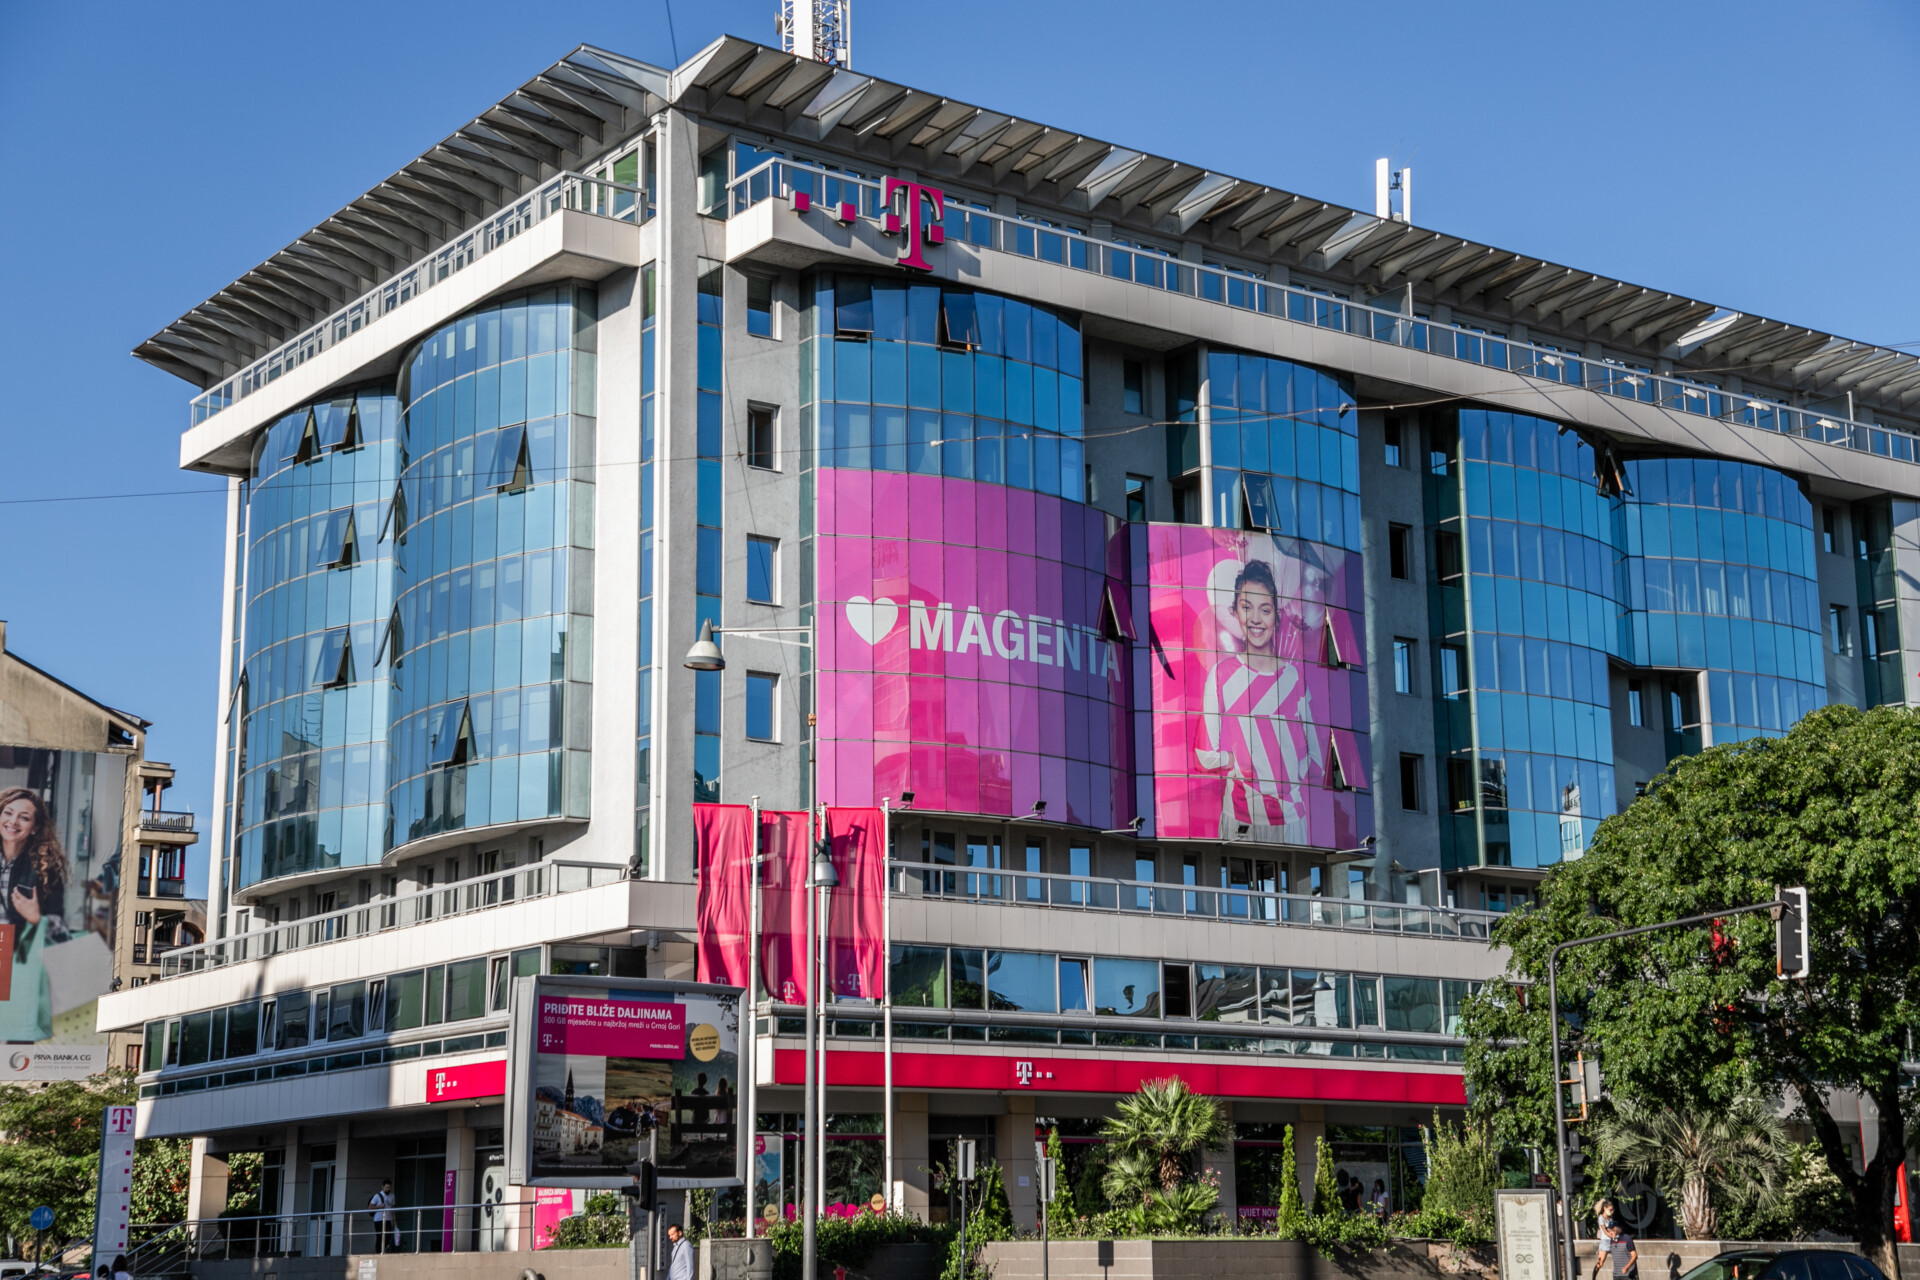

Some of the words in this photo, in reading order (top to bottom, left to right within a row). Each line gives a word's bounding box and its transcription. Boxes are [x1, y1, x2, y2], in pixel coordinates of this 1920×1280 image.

[910, 599, 1121, 682] MAGENTA
[544, 1002, 584, 1016] PRIĐITE
[586, 1004, 615, 1018] BLIŽE
[617, 1007, 672, 1020] DALJINAMA
[544, 1016, 555, 1024] 500
[567, 1018, 596, 1027] mjesečno
[603, 1021, 627, 1029] najbržoj
[628, 1021, 644, 1029] mreži
[651, 1022, 666, 1031] Crnoj
[668, 1022, 680, 1030] Gori
